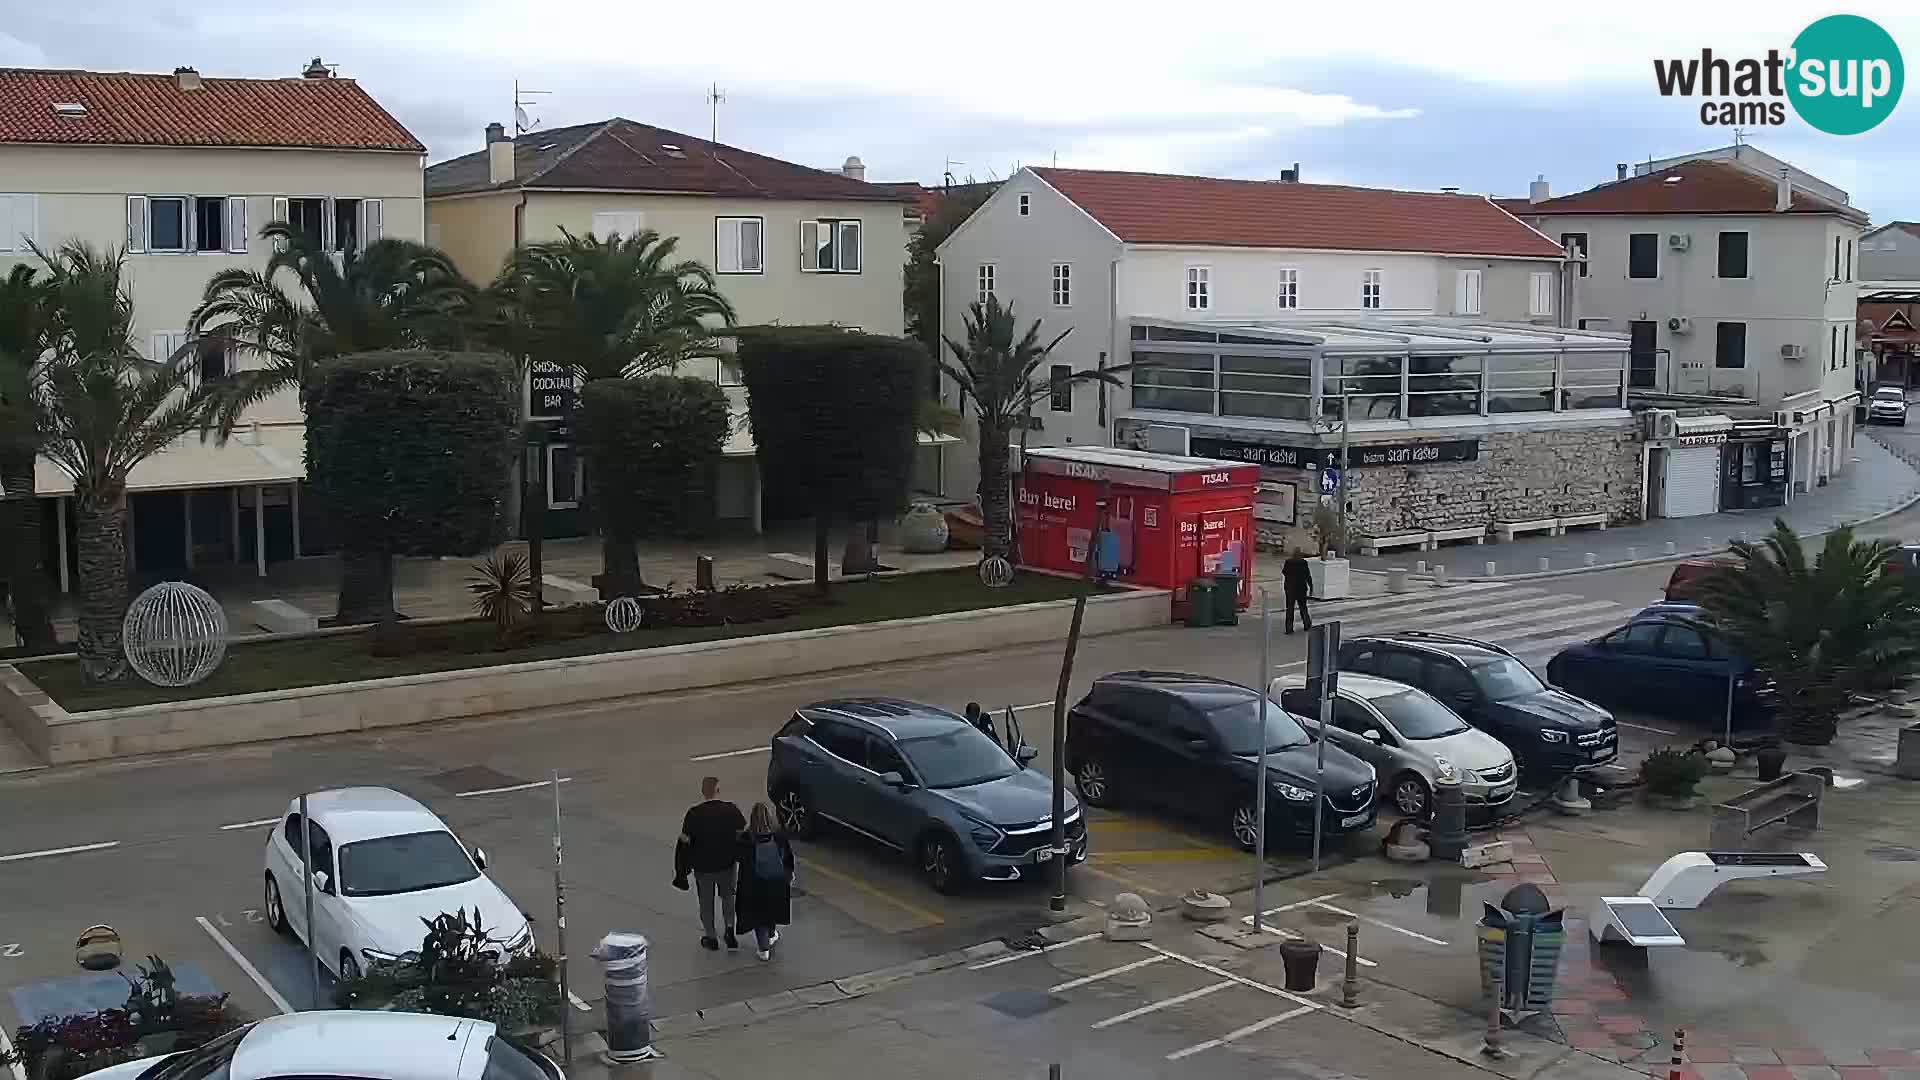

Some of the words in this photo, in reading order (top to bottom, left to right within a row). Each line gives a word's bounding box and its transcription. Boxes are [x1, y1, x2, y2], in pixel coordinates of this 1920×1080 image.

[544, 394, 562, 408] BAR
[1065, 463, 1099, 480] TISAK
[1201, 472, 1230, 485] TISAK
[1020, 487, 1039, 505] Buy
[1043, 491, 1076, 512] here!
[1180, 521, 1198, 533] Buy
